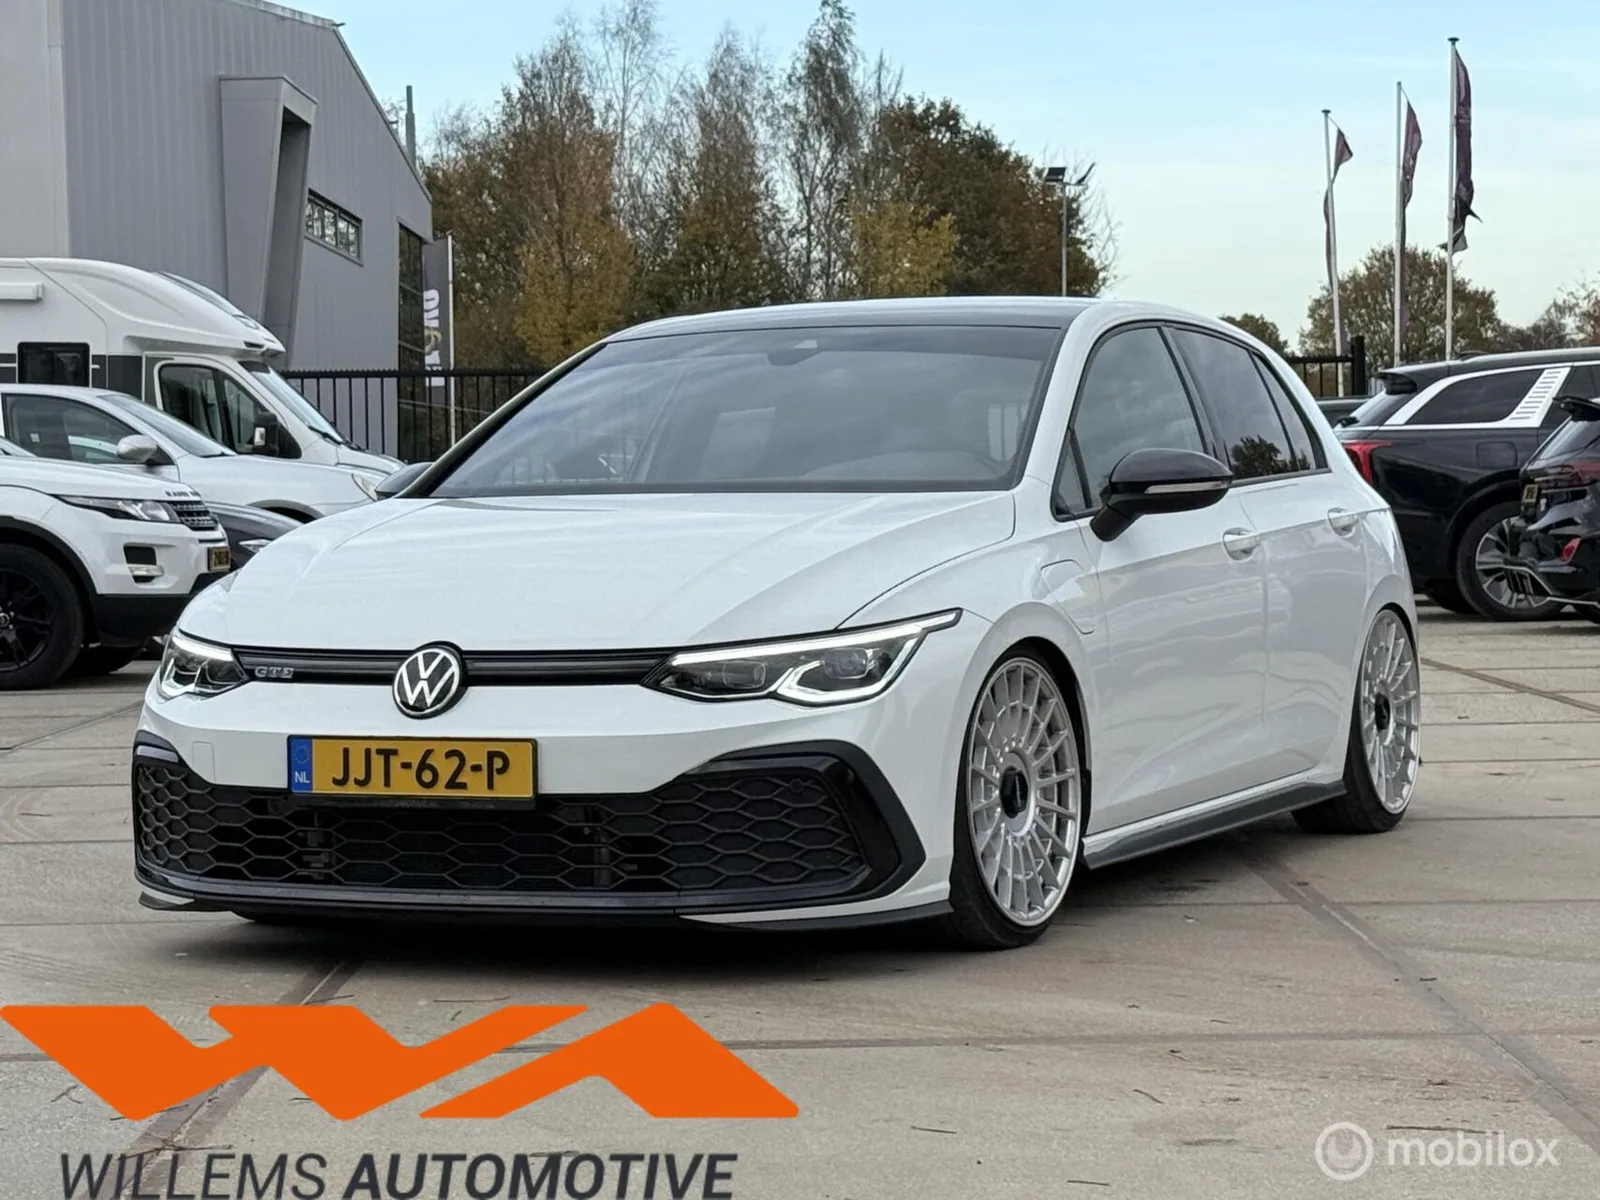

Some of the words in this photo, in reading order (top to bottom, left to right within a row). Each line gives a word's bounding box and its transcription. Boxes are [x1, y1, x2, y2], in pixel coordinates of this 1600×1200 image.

[254, 665, 295, 679] GTE
[331, 746, 511, 791] JJT-62-P
[294, 770, 311, 783] NL
